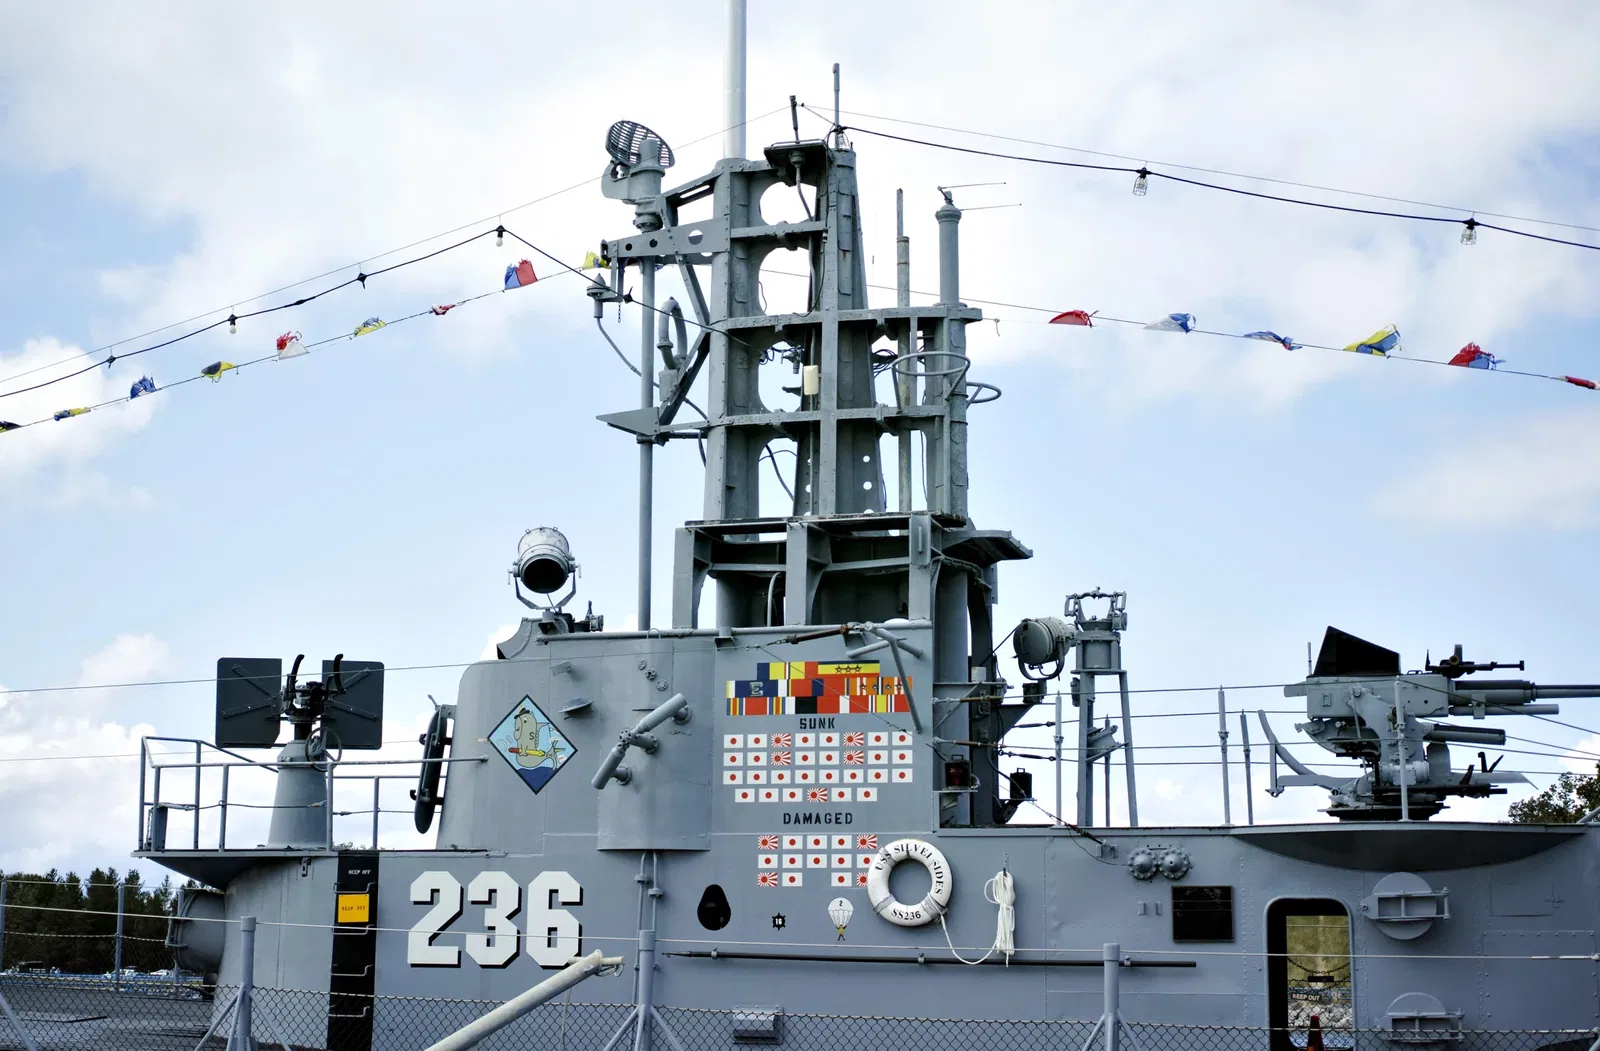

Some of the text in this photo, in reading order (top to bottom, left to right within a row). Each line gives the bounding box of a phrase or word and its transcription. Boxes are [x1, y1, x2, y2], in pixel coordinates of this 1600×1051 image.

[749, 681, 763, 697] E
[799, 717, 836, 730] SUNK
[528, 731, 535, 740] S
[783, 812, 853, 825] DAMAGED
[875, 852, 892, 871] USS
[407, 870, 584, 970] 236
[891, 908, 921, 920] SS236
